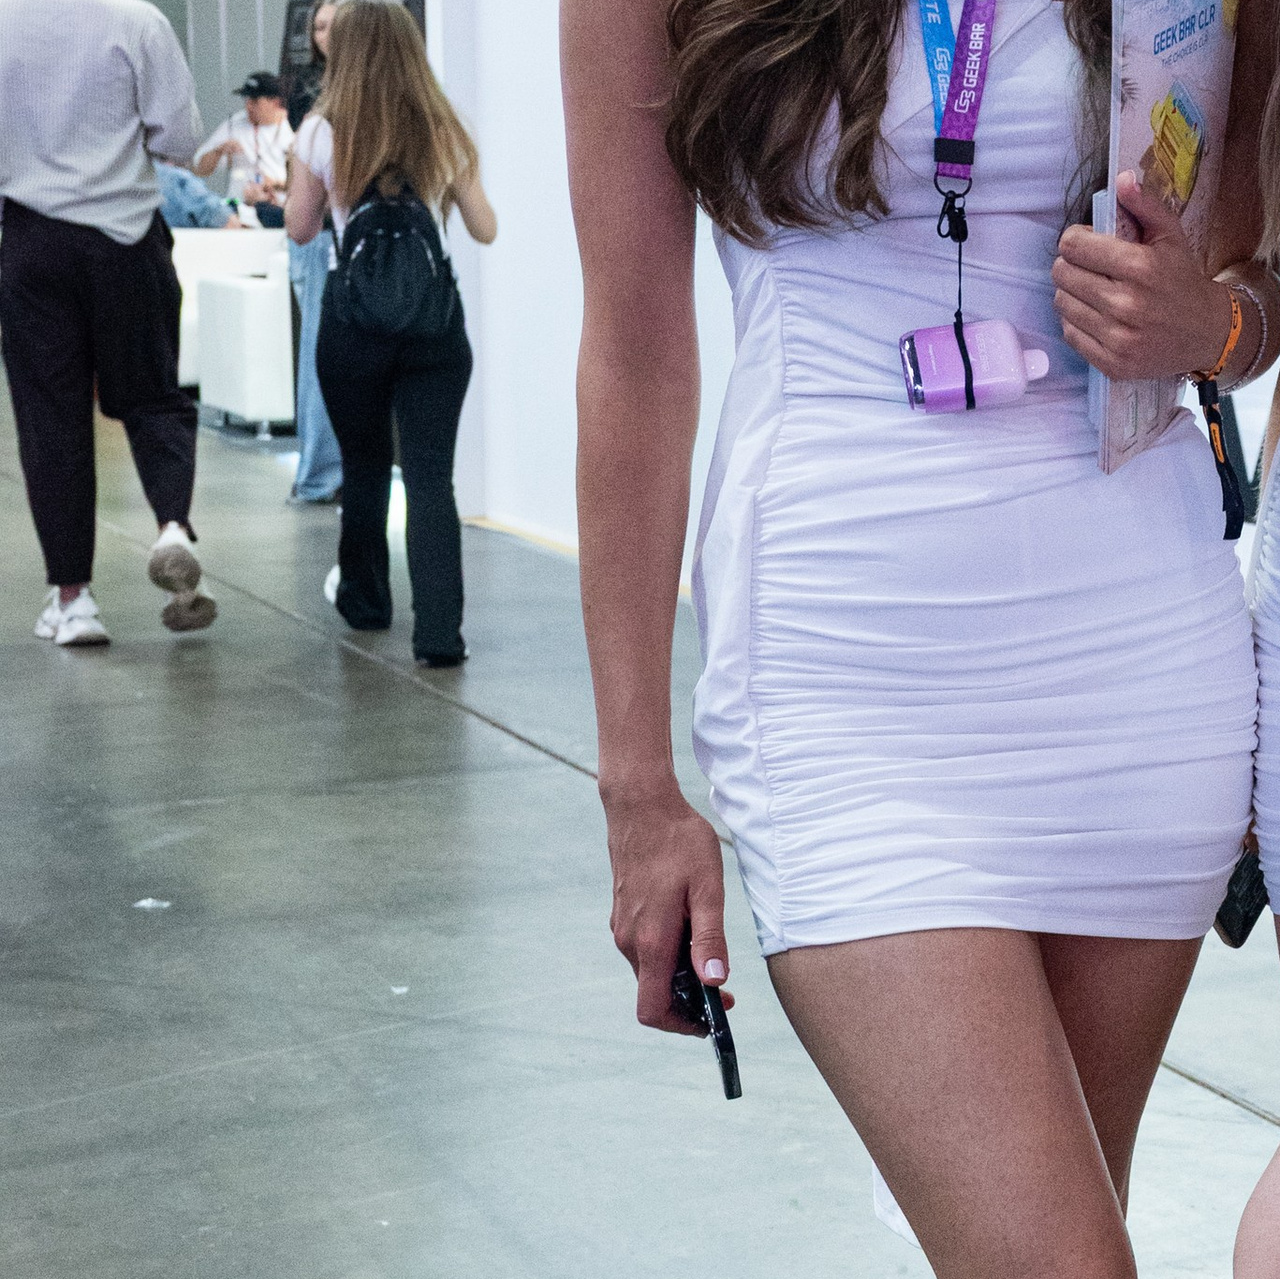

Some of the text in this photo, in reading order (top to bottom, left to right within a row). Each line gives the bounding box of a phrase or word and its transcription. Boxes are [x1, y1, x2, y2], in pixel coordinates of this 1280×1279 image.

[963, 22, 986, 88] GEEK BAR
[1153, 3, 1216, 55] GEEK BAR CLR
